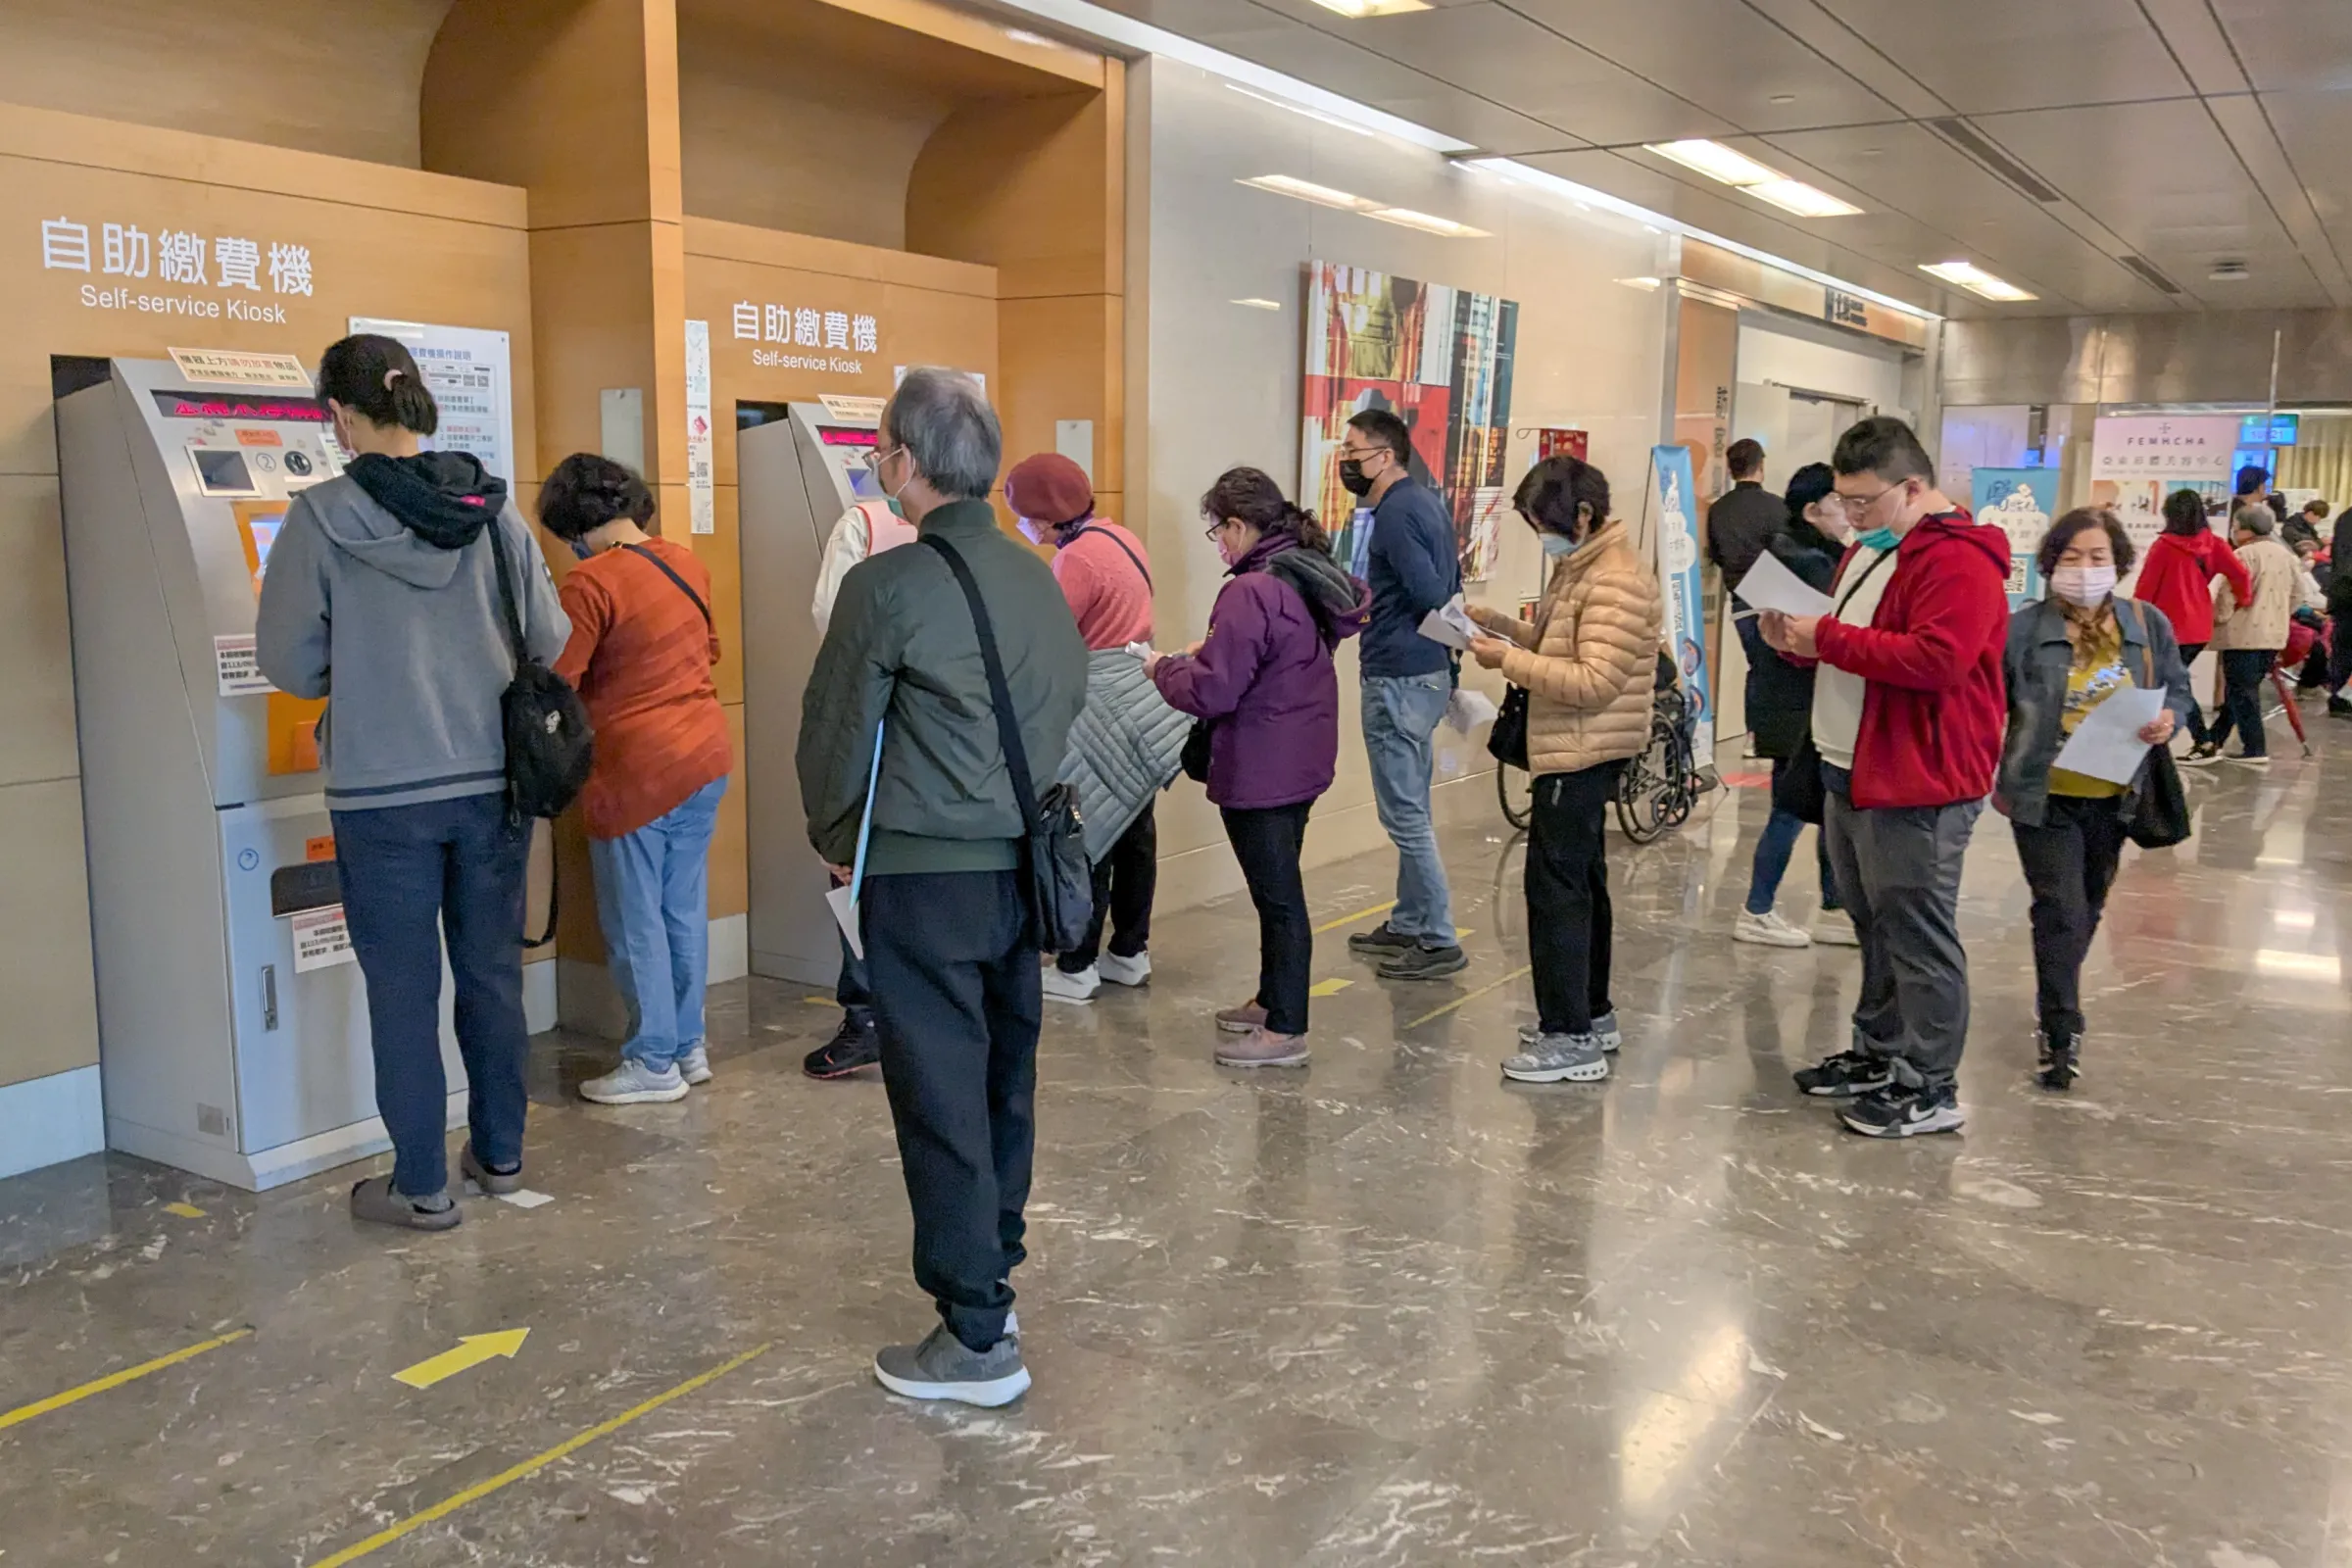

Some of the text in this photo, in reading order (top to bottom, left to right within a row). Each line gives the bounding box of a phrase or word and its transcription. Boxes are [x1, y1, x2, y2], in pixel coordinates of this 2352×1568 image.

[41, 216, 314, 297] 自助繳費機
[80, 284, 287, 324] Self-service Kiosk
[733, 299, 878, 354] 自助繳費機
[752, 349, 863, 374] Self-service Kiosk
